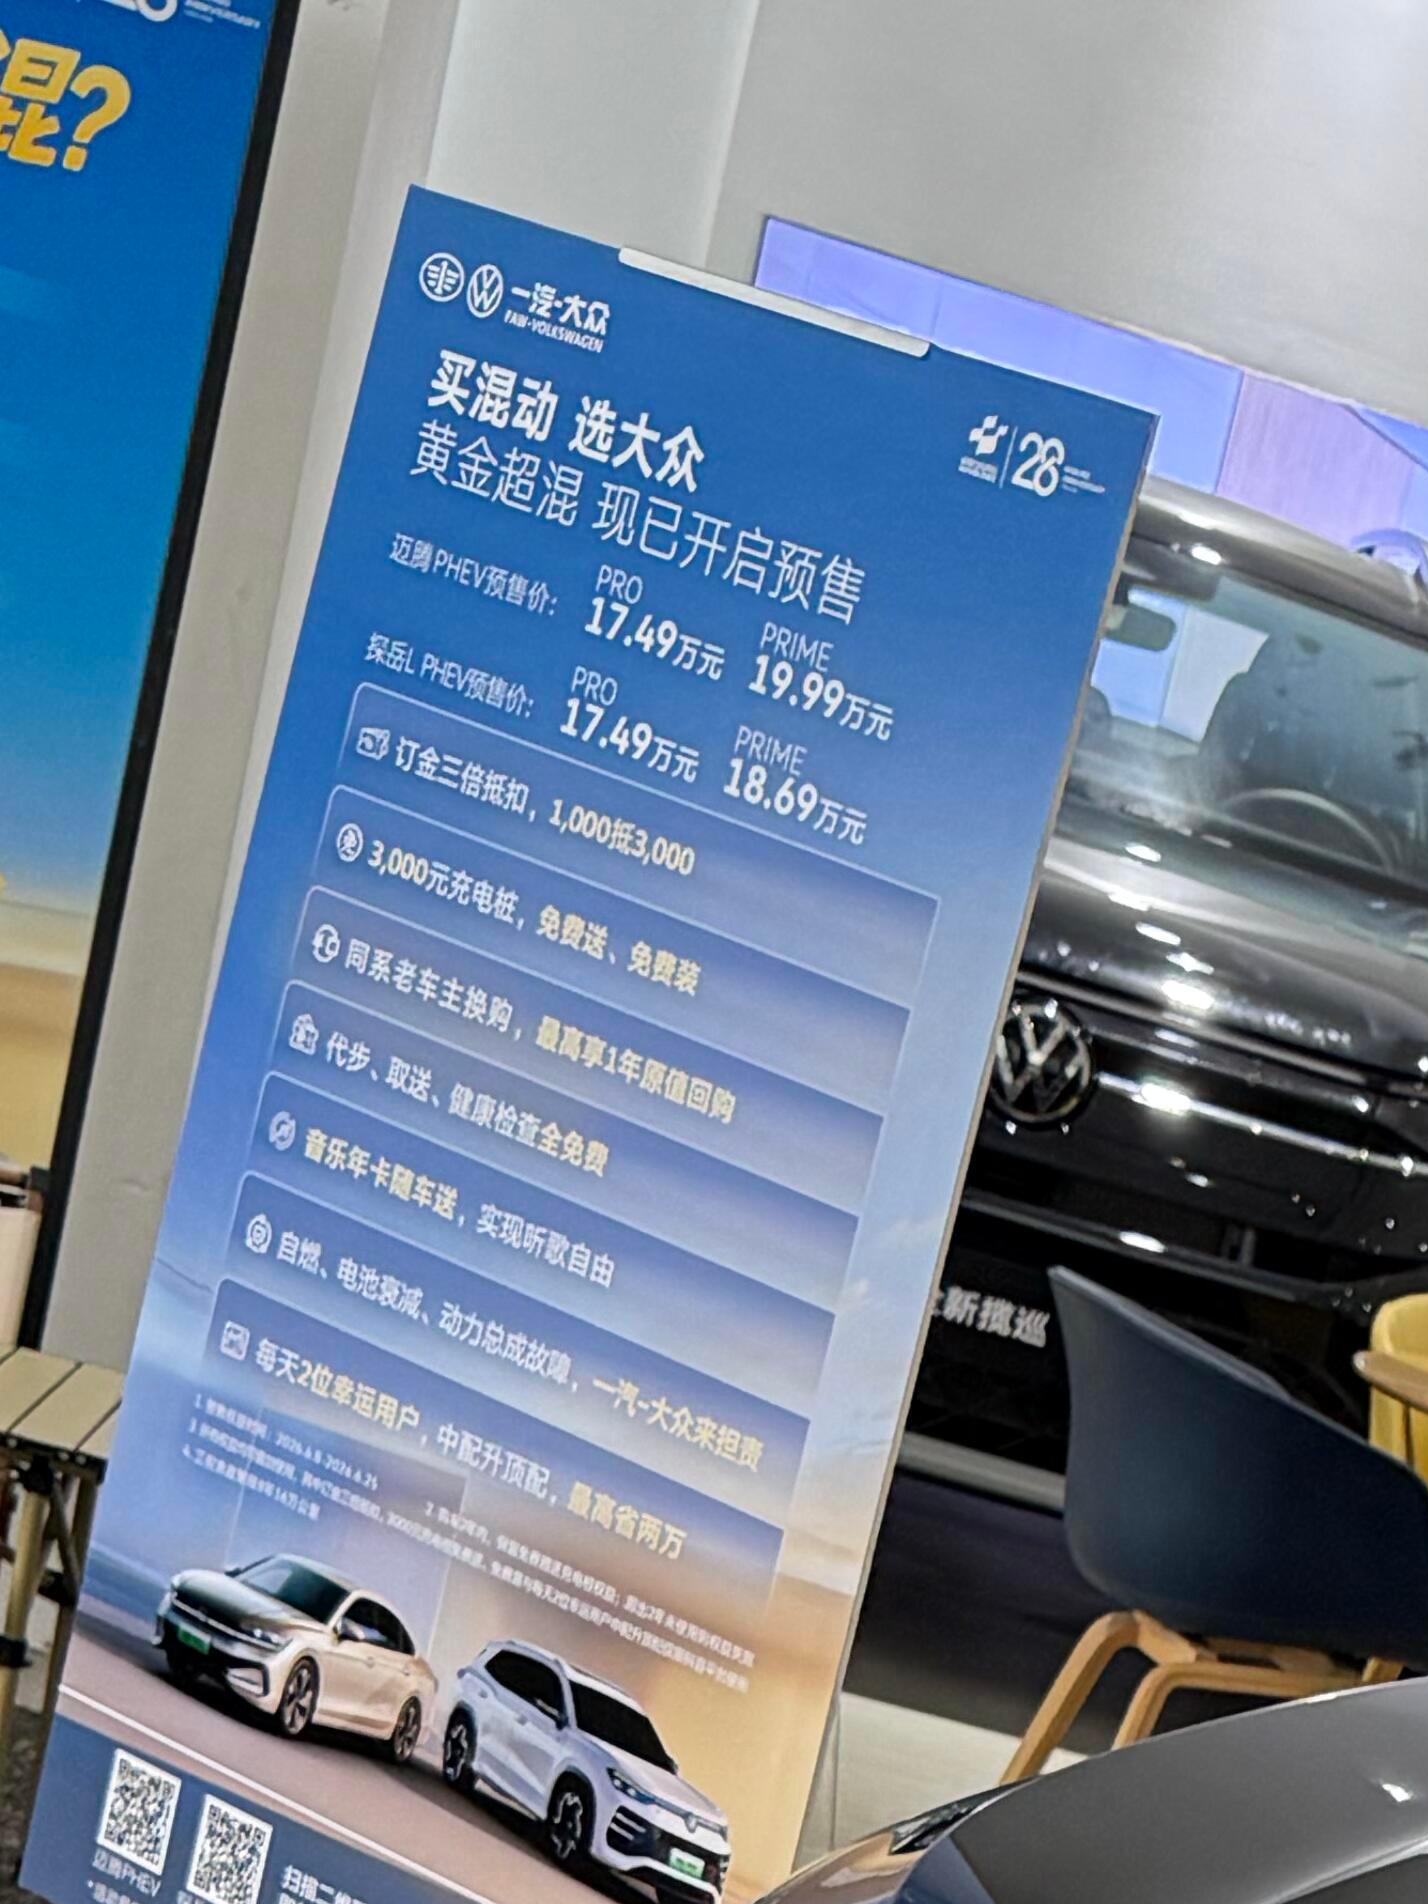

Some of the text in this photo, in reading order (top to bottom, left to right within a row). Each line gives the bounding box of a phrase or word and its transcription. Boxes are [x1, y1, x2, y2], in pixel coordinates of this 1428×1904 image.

[428, 349, 705, 493] 买混动 选大众
[410, 418, 866, 625] 黄金超混 现已开启预售
[596, 564, 644, 605] PRO
[584, 596, 726, 681] 17.49万元
[759, 621, 835, 673] PRIME
[571, 666, 618, 707] PRO
[748, 655, 895, 741] 19.99万元
[560, 698, 702, 784] 17.49万元
[734, 725, 808, 778] PRIME
[723, 758, 869, 845] 18.69万元
